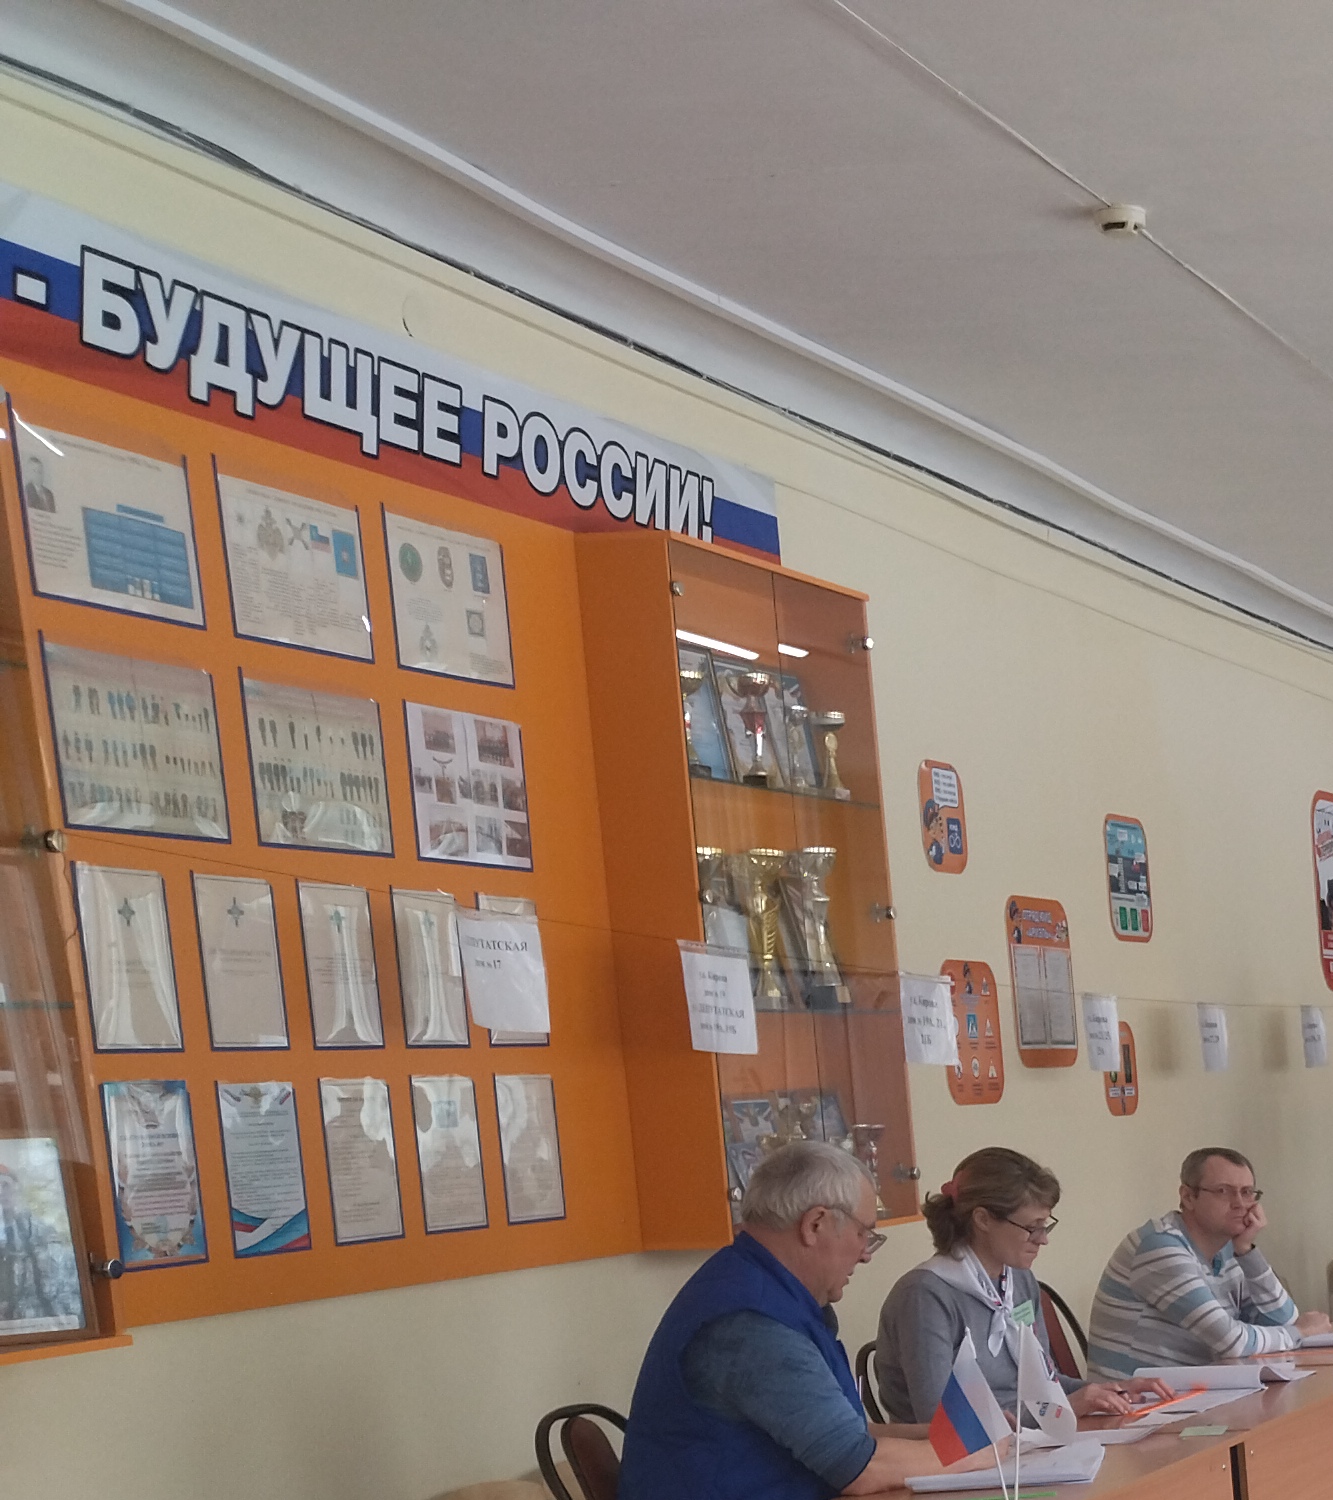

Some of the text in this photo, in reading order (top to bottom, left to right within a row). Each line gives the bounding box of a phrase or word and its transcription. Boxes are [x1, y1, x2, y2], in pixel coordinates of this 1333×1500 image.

[79, 244, 464, 468] БУДУЩЕЕ
[480, 393, 718, 545] РОССИИ!
[465, 935, 528, 952] УТАТСКАЯ
